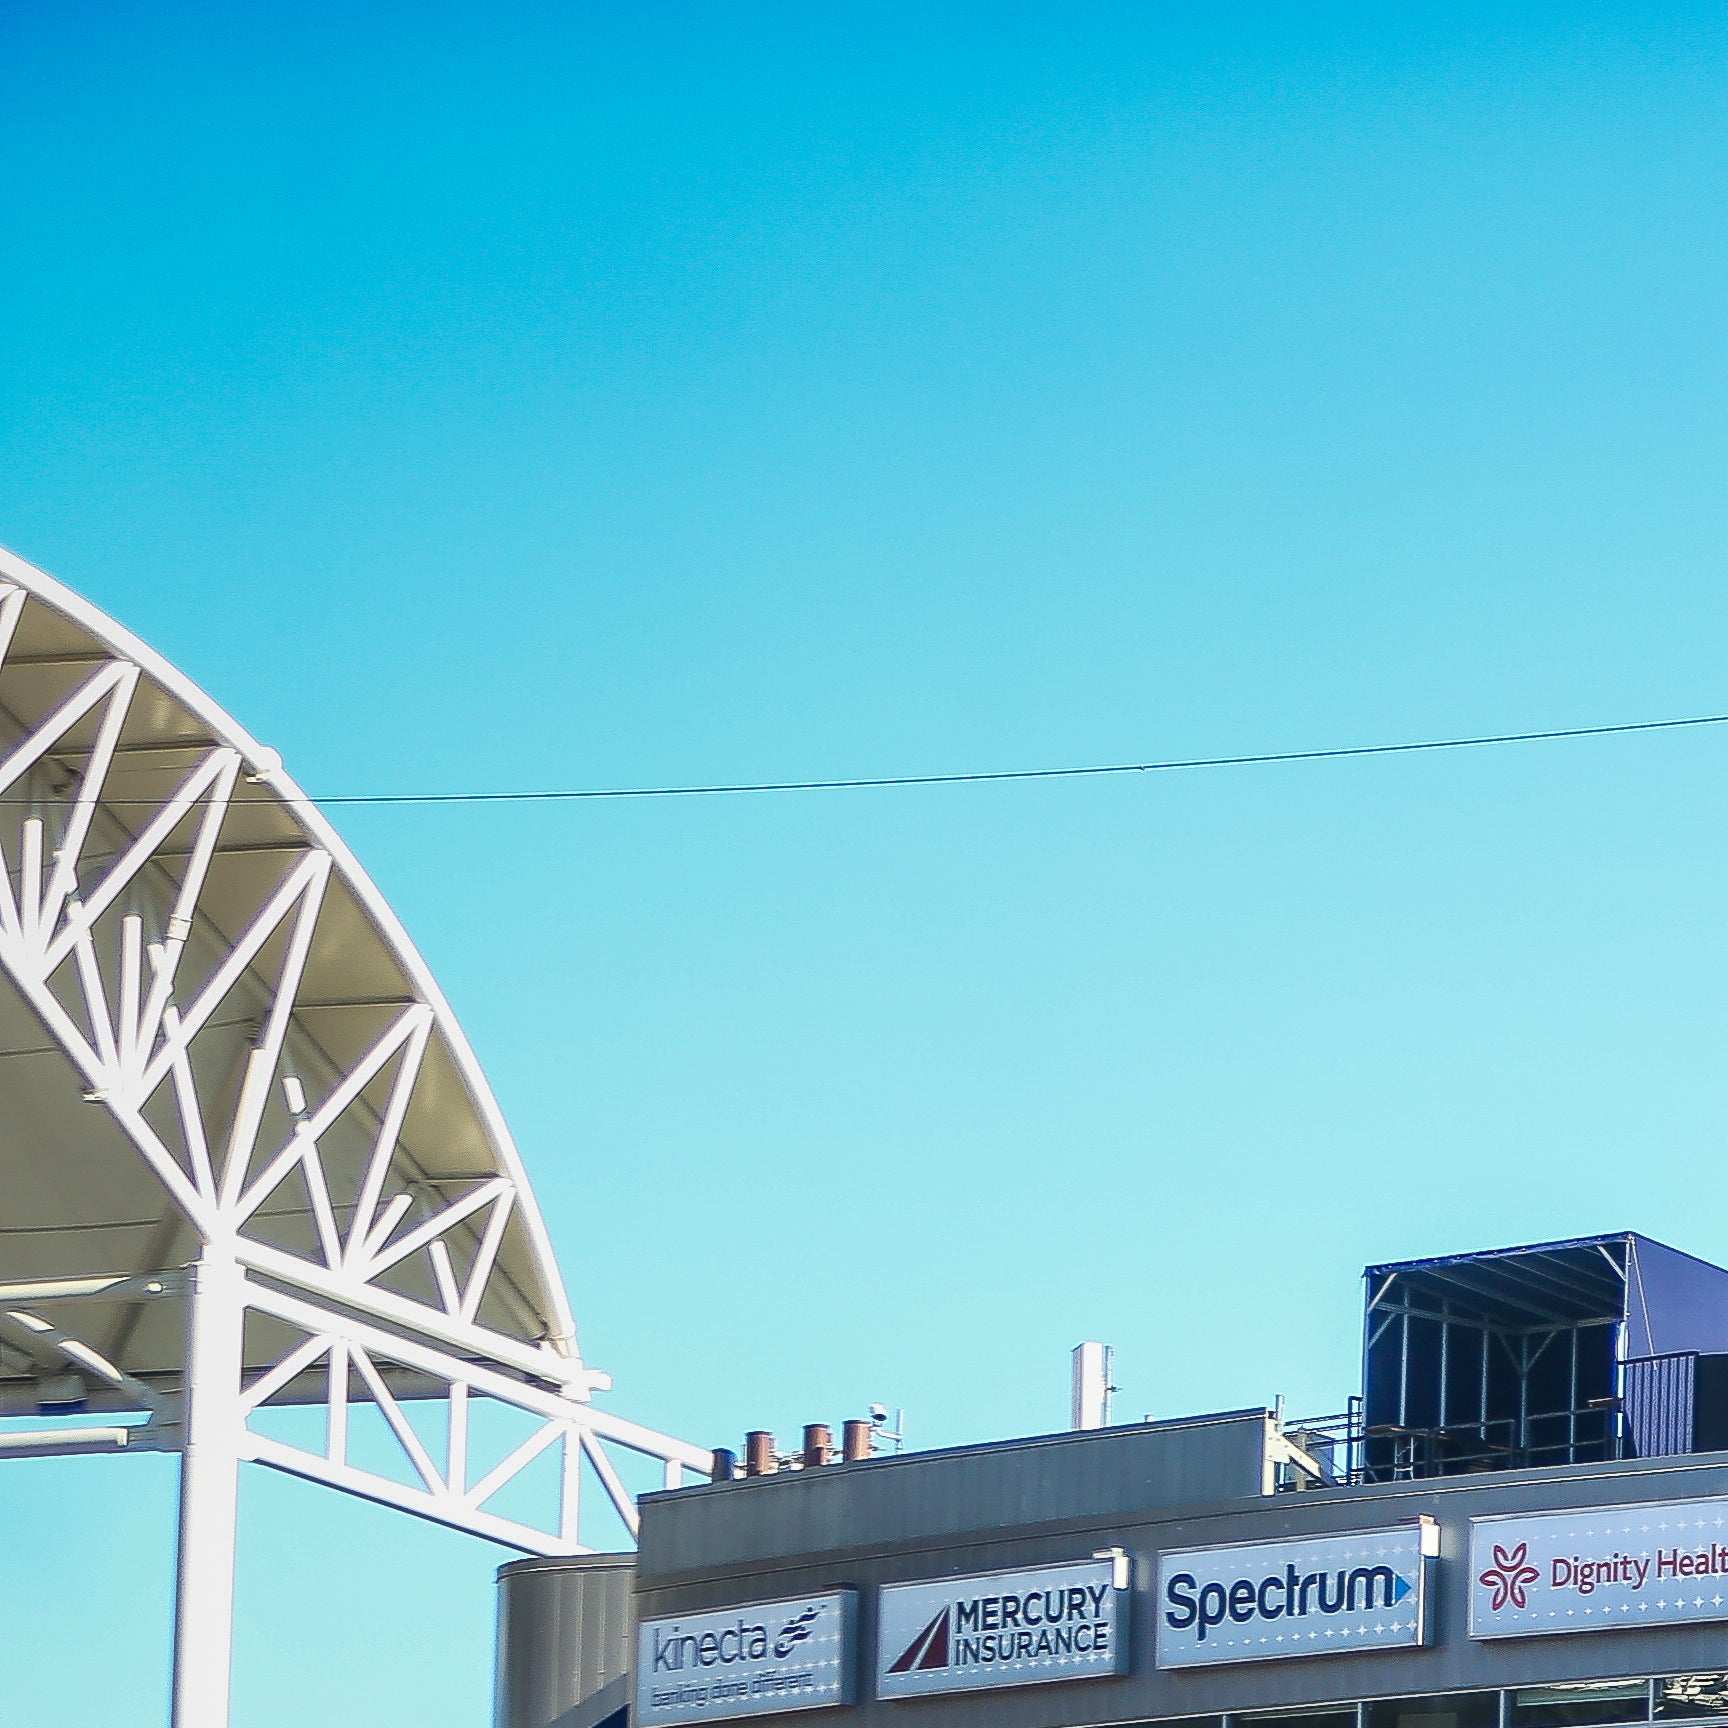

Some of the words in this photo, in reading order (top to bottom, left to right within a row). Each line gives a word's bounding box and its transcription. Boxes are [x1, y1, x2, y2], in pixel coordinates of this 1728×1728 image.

[1551, 1555, 1650, 1595] Dignity
[957, 1584, 1110, 1634] MERCURY
[1166, 1563, 1395, 1640] Spectrum
[652, 1618, 768, 1673] kinecta
[956, 1621, 1109, 1666] INSURANCE
